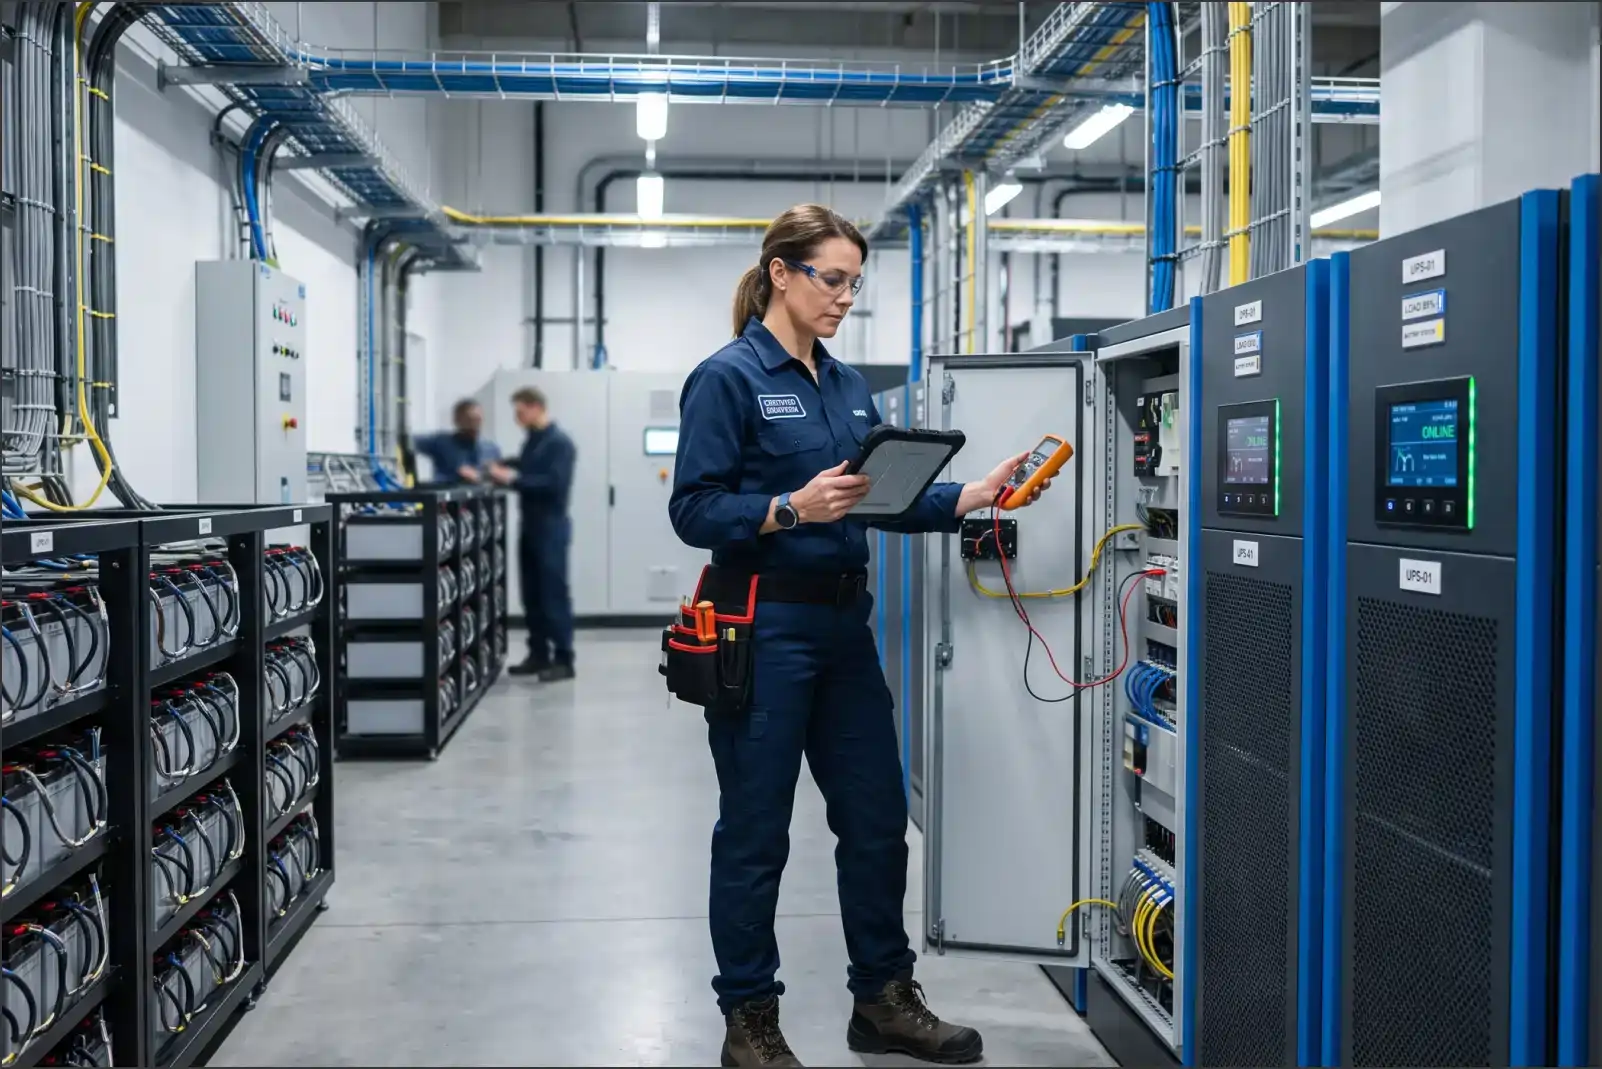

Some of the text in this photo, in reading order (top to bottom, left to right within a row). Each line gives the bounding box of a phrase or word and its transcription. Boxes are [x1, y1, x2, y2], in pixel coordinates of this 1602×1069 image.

[1410, 260, 1435, 275] UPS-01
[1422, 424, 1455, 439] ONLINE
[1405, 569, 1432, 584] UPS-01
